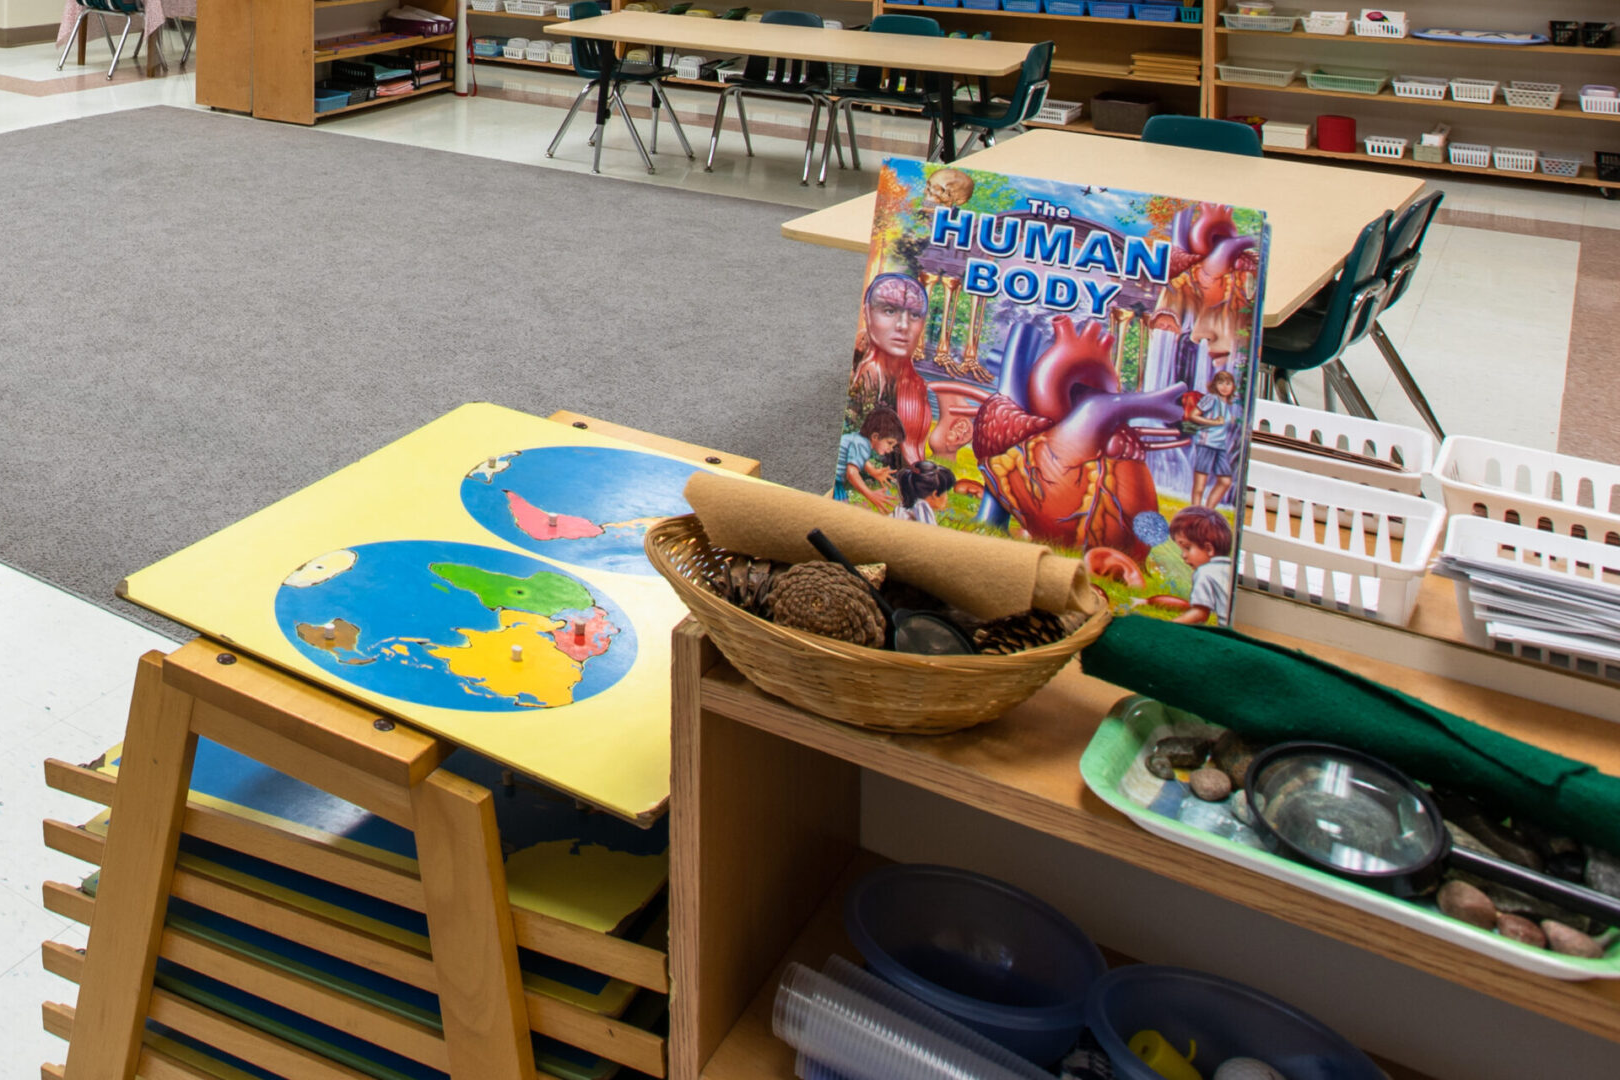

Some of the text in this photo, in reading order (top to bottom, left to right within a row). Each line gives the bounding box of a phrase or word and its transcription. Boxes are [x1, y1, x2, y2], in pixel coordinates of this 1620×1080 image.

[1026, 198, 1071, 221] The
[931, 206, 1170, 284] HUMAN
[964, 258, 1121, 318] BODY
